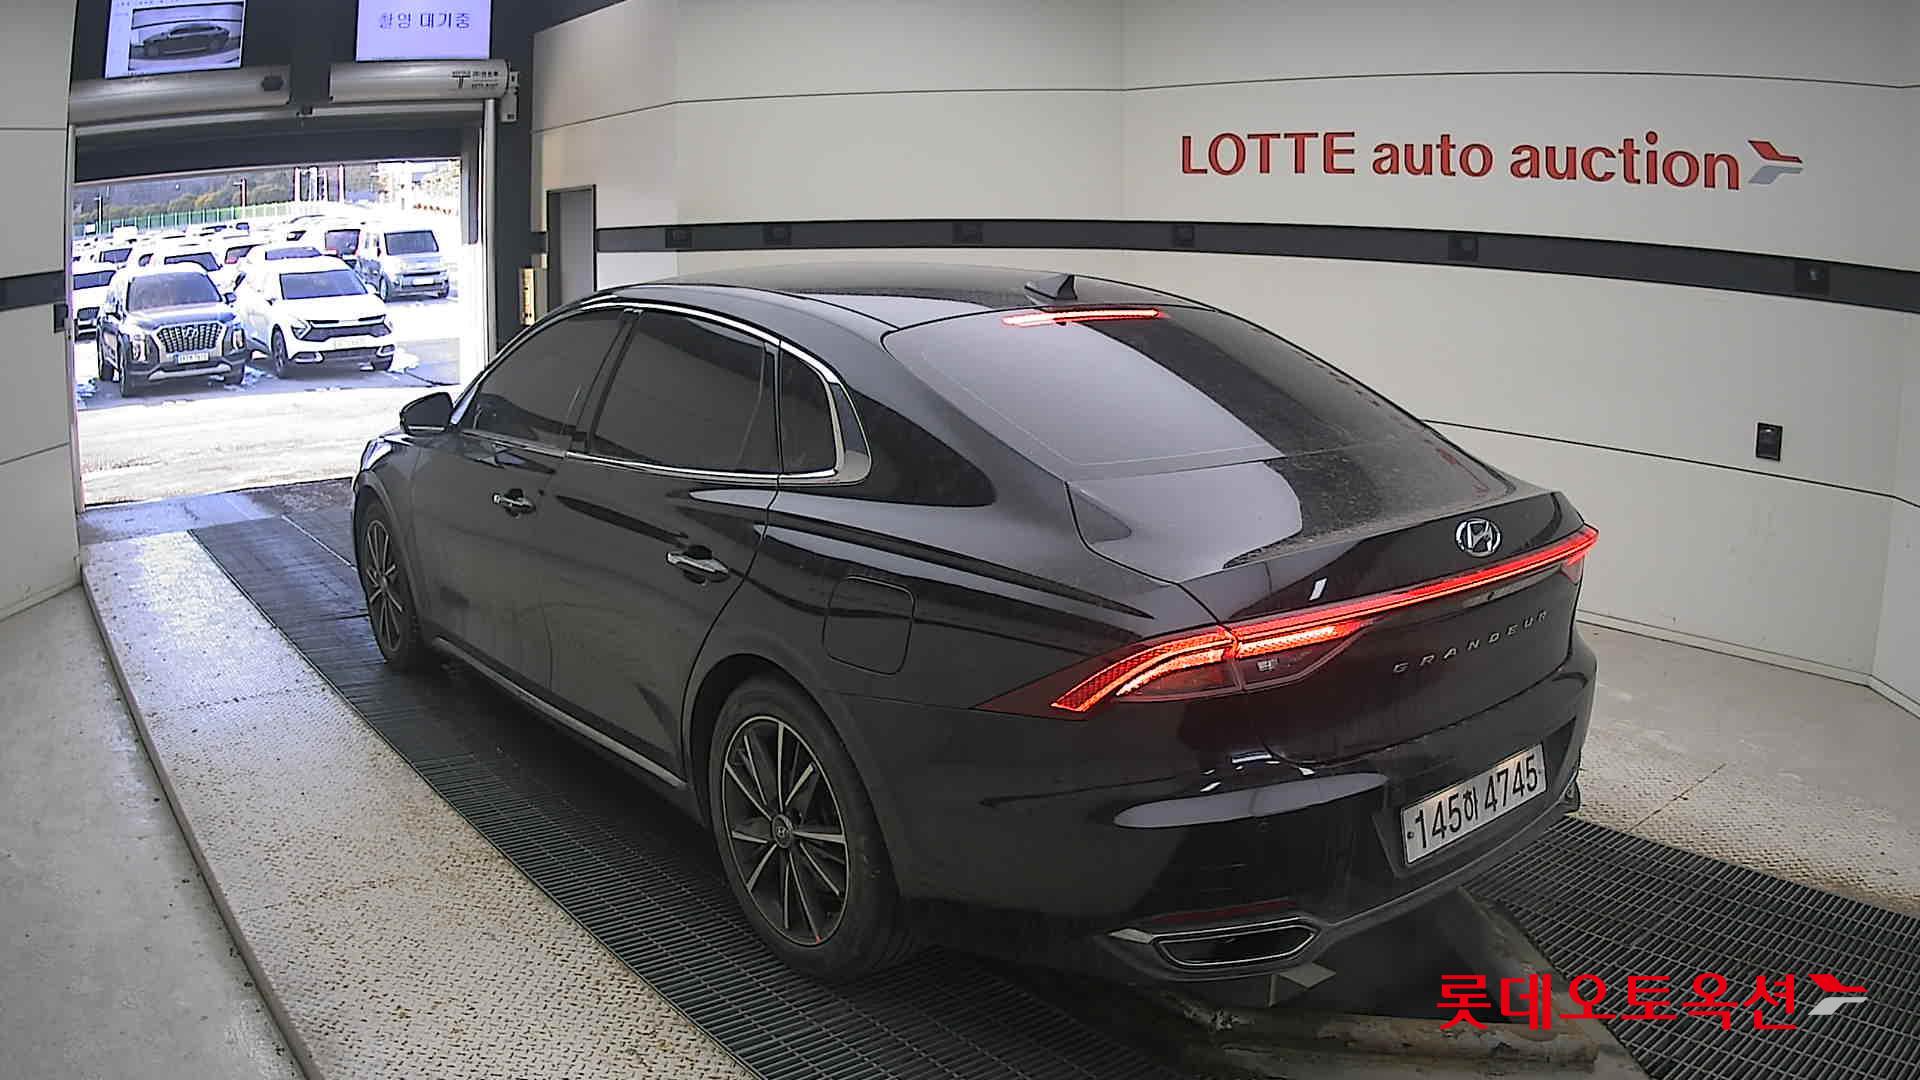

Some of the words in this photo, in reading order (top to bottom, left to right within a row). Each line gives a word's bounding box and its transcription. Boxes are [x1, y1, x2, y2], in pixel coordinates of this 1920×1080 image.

[420, 13, 470, 29] 대기중
[1182, 132, 1355, 175] LOTTE
[1372, 133, 1493, 177] auto
[1510, 131, 1741, 190] auction
[1393, 608, 1549, 673] GRANDEUR
[1484, 754, 1538, 812] 4745
